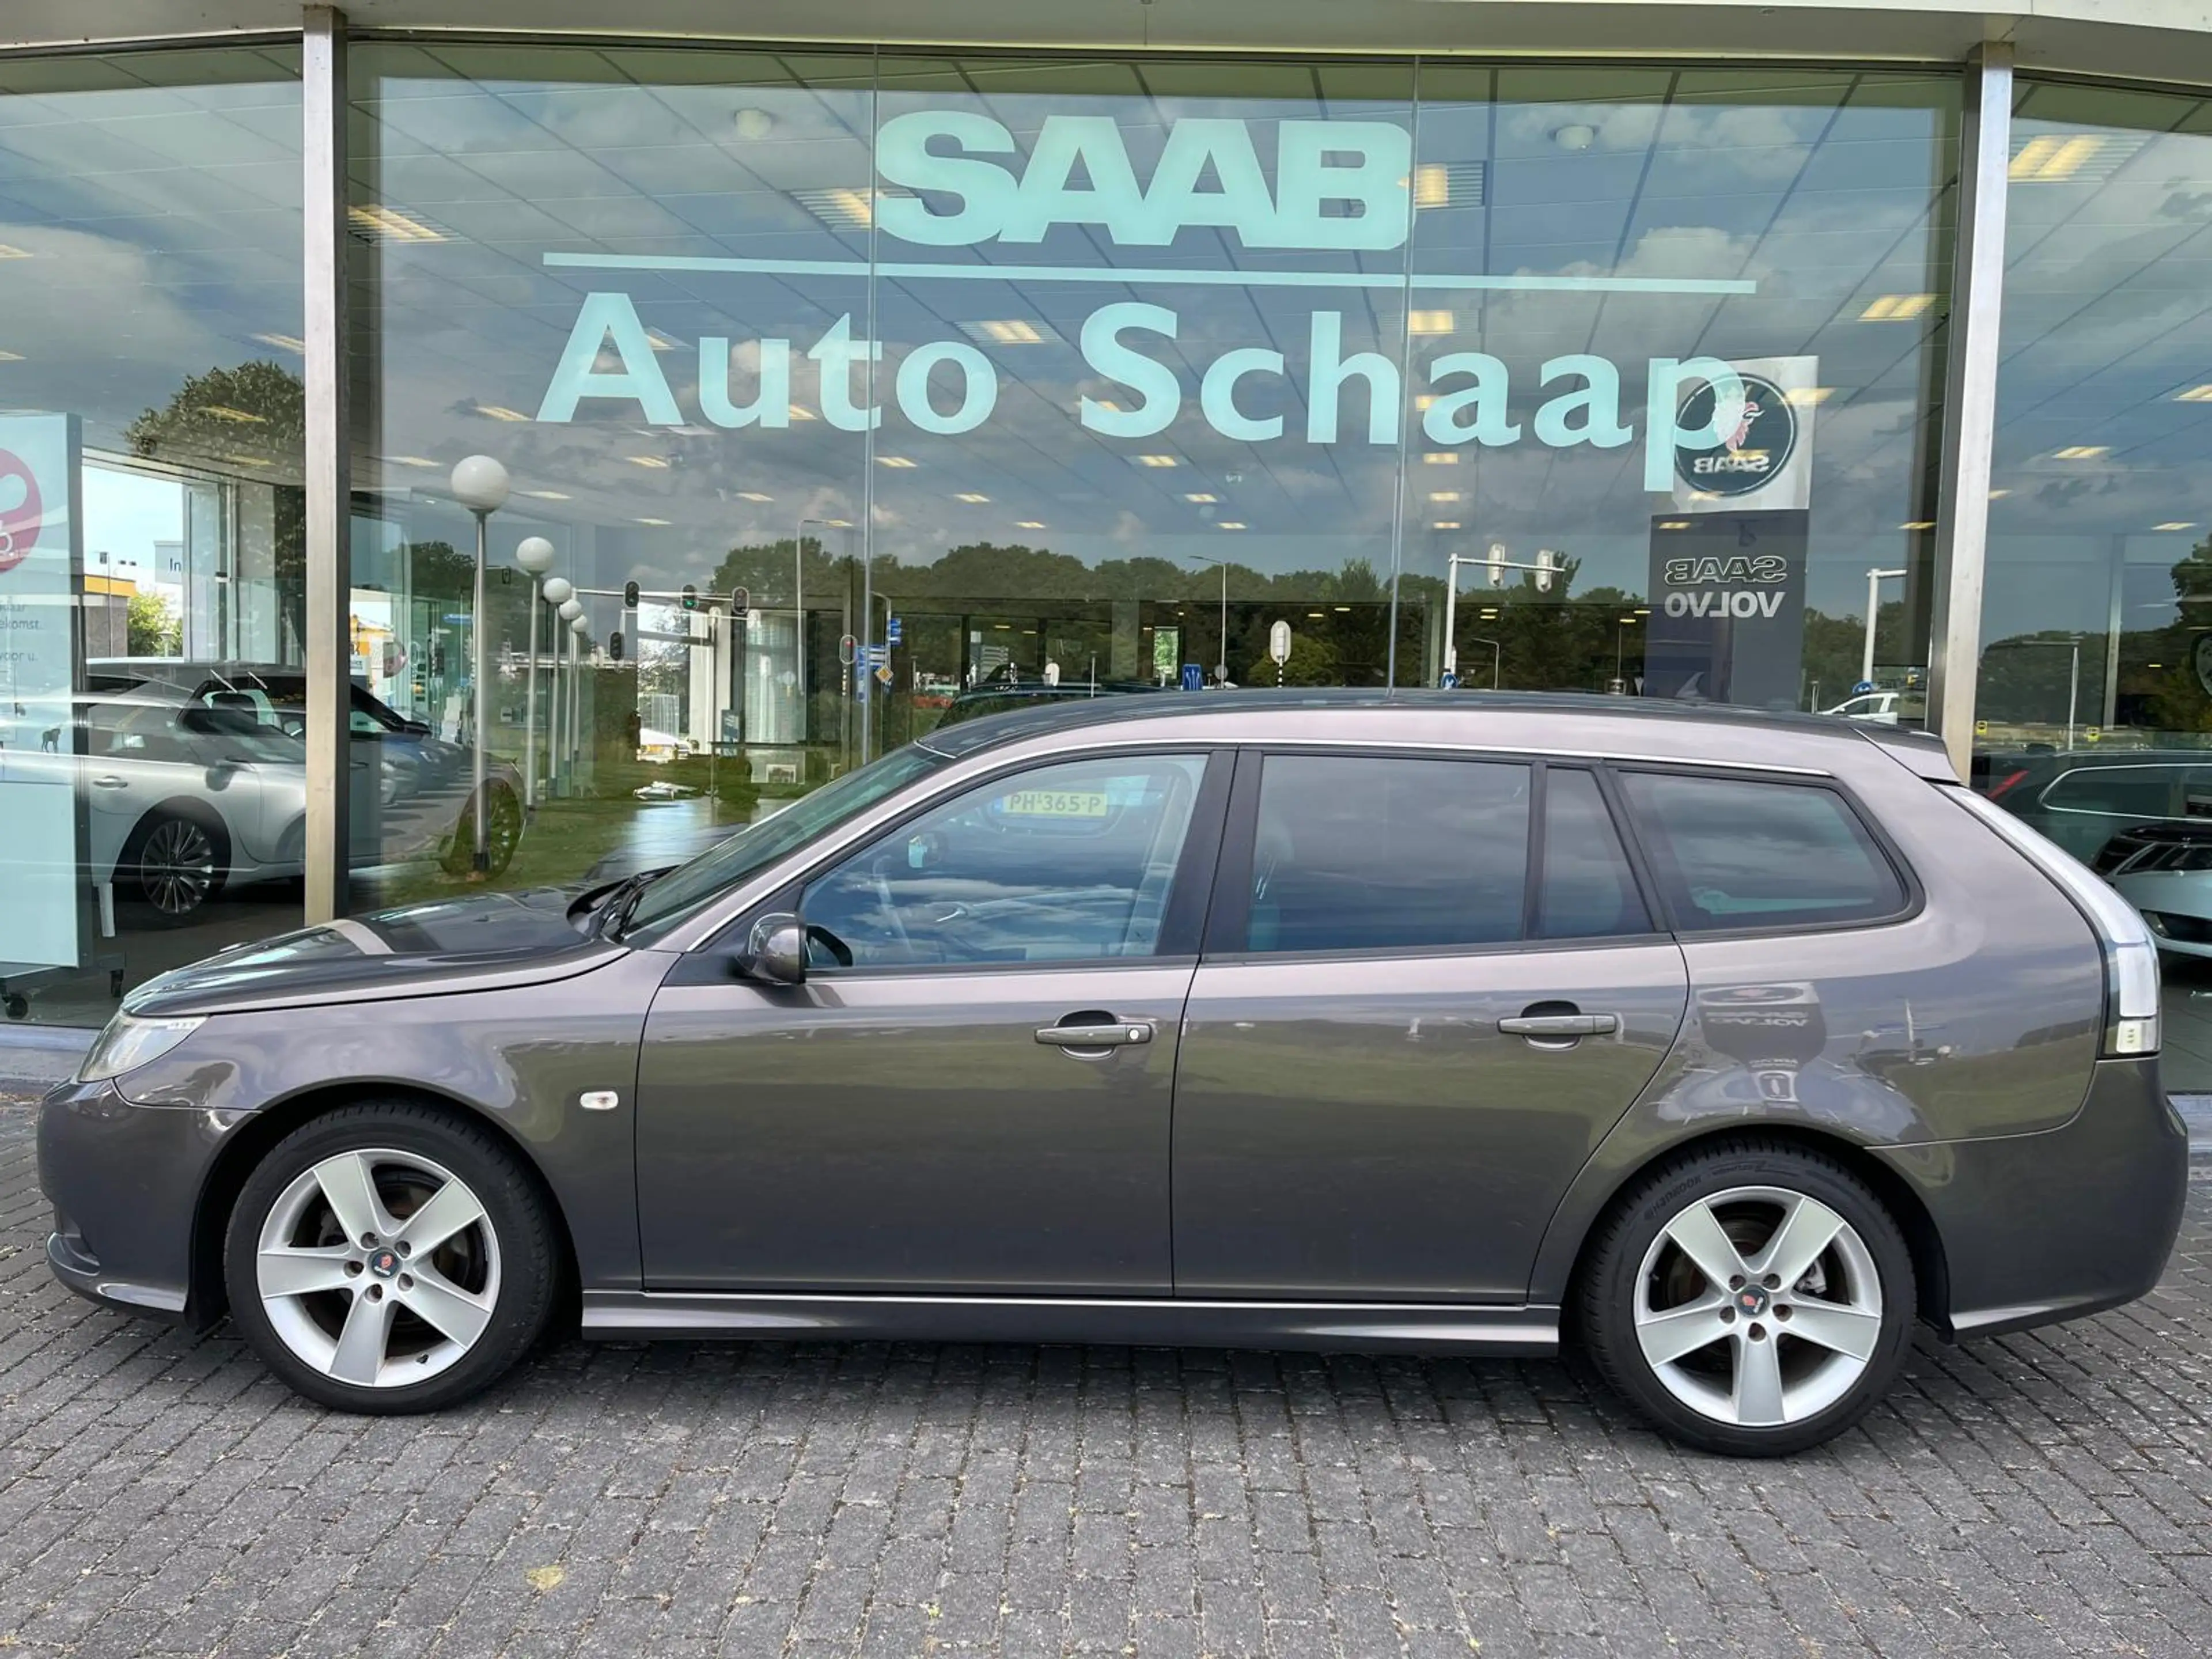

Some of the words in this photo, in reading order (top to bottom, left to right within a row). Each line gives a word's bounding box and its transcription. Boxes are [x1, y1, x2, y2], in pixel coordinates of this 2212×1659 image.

[875, 110, 1411, 251] SAAB
[536, 291, 999, 434] Auto
[1079, 301, 1746, 492] Schaap
